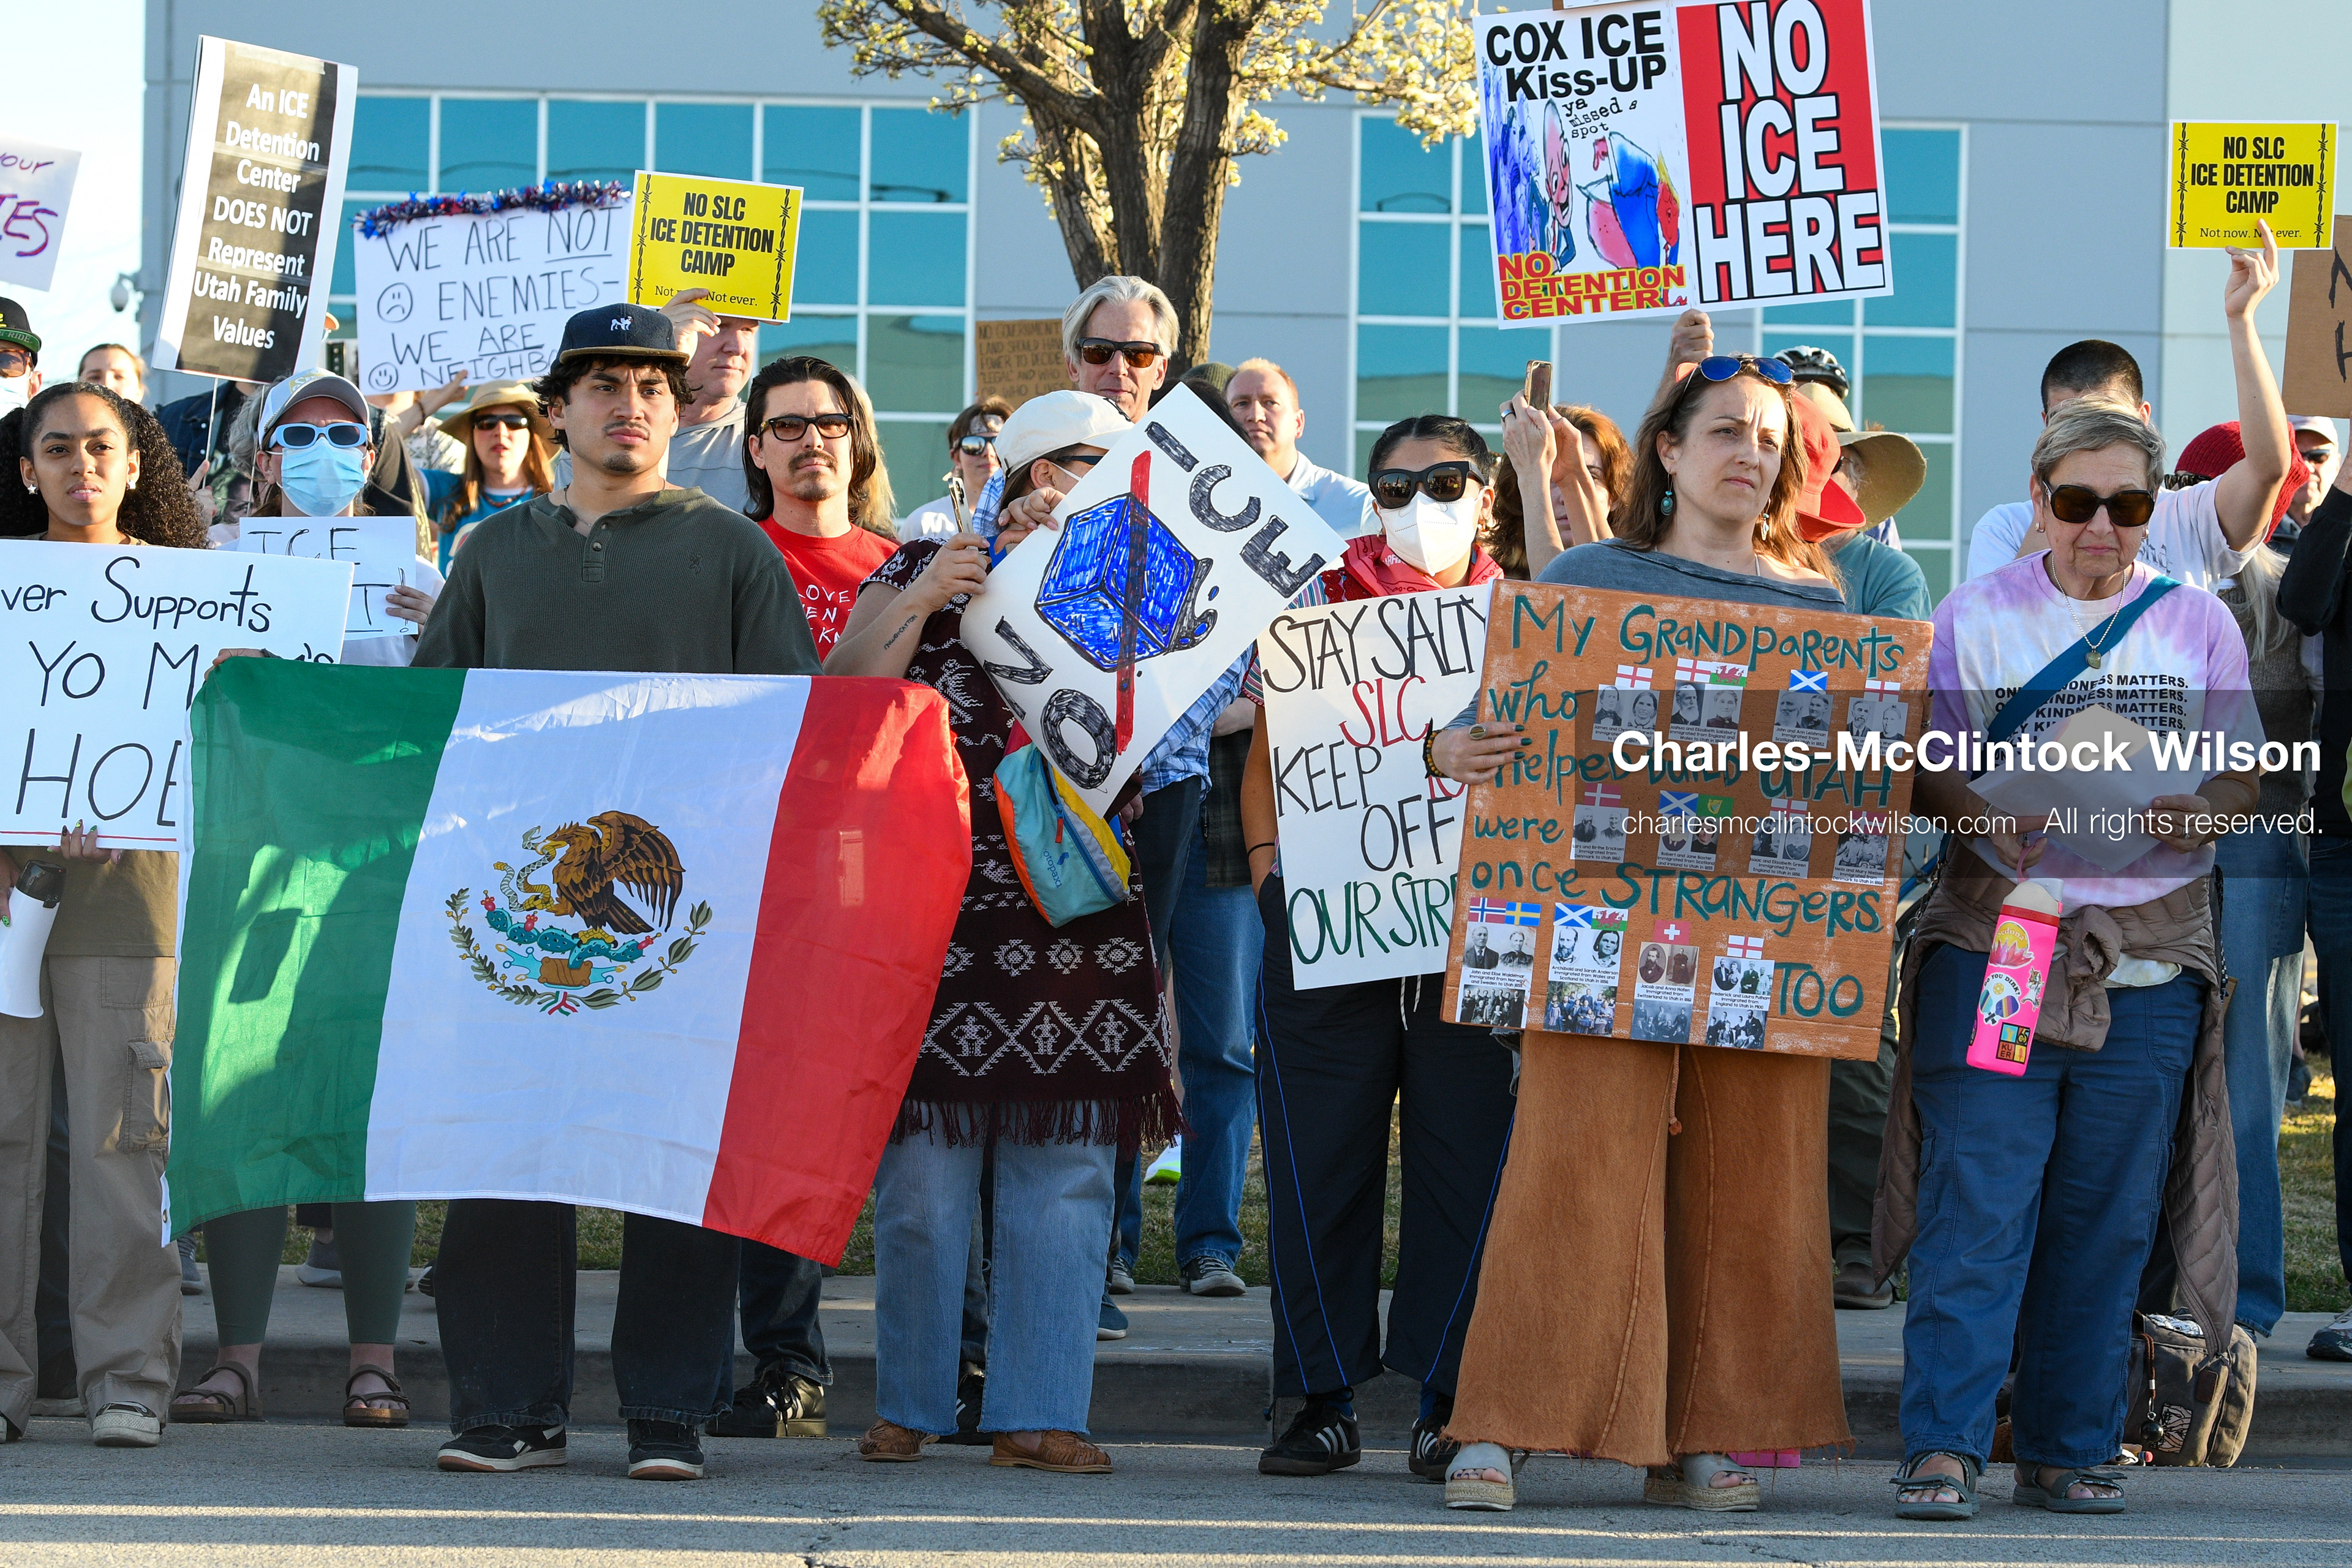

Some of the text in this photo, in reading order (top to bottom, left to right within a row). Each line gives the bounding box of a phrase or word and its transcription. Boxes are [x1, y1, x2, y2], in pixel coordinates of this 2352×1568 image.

[1486, 10, 1665, 66] COX ICE
[1718, 0, 1828, 100] NO
[1506, 54, 1667, 102] Kiss-UP
[246, 83, 308, 118] An ICE
[1562, 98, 1588, 116] ya
[1569, 97, 1623, 127] missed
[225, 121, 320, 162] Detention
[1571, 123, 1609, 139] spot
[1722, 94, 1844, 202] ICE
[2223, 136, 2285, 159] NO SLC
[236, 159, 301, 194] Center
[2191, 163, 2314, 186] ICE DETENTION
[213, 195, 312, 236] DOES NOT
[683, 191, 746, 219] NO SLC
[2226, 191, 2279, 213] CAMP
[384, 206, 623, 272] WE ARE NOT
[650, 218, 775, 254] ICE DETENTION
[1694, 191, 1885, 303] HERE
[2199, 227, 2220, 238] Not
[2223, 229, 2251, 238] now.
[2276, 229, 2302, 238] ever.
[208, 237, 305, 277] Represent
[680, 248, 736, 277] CAMP
[1498, 251, 1552, 281] NO
[194, 272, 308, 319] Utah Family
[439, 267, 619, 321] ENEMIES-
[655, 285, 675, 298] Not
[705, 289, 726, 303] Not
[729, 295, 758, 307] ever.
[1500, 265, 1685, 301] DETENTION
[1503, 288, 1665, 321] CENTER
[213, 315, 275, 350] Values
[391, 323, 541, 365] WE ARE
[1145, 421, 1326, 598] ICE
[91, 556, 272, 633] Supports
[799, 584, 851, 603] OVE
[803, 604, 837, 623] EN
[1262, 605, 1368, 692] STAY
[2116, 688, 2188, 703] MATTERS.
[2117, 674, 2188, 688] MATTERS.
[1338, 675, 1428, 748] SLC
[2115, 703, 2187, 717] MATTERS.
[1273, 740, 1381, 818] KEEP
[1360, 796, 1454, 871] OFF
[1474, 815, 1564, 844] were
[1043, 849, 1063, 889] otopaxi
[1471, 860, 1586, 900] once
[1287, 871, 1458, 965] OUR STR
[1774, 962, 1863, 1018] TOO
[2002, 1042, 2013, 1051] KU
